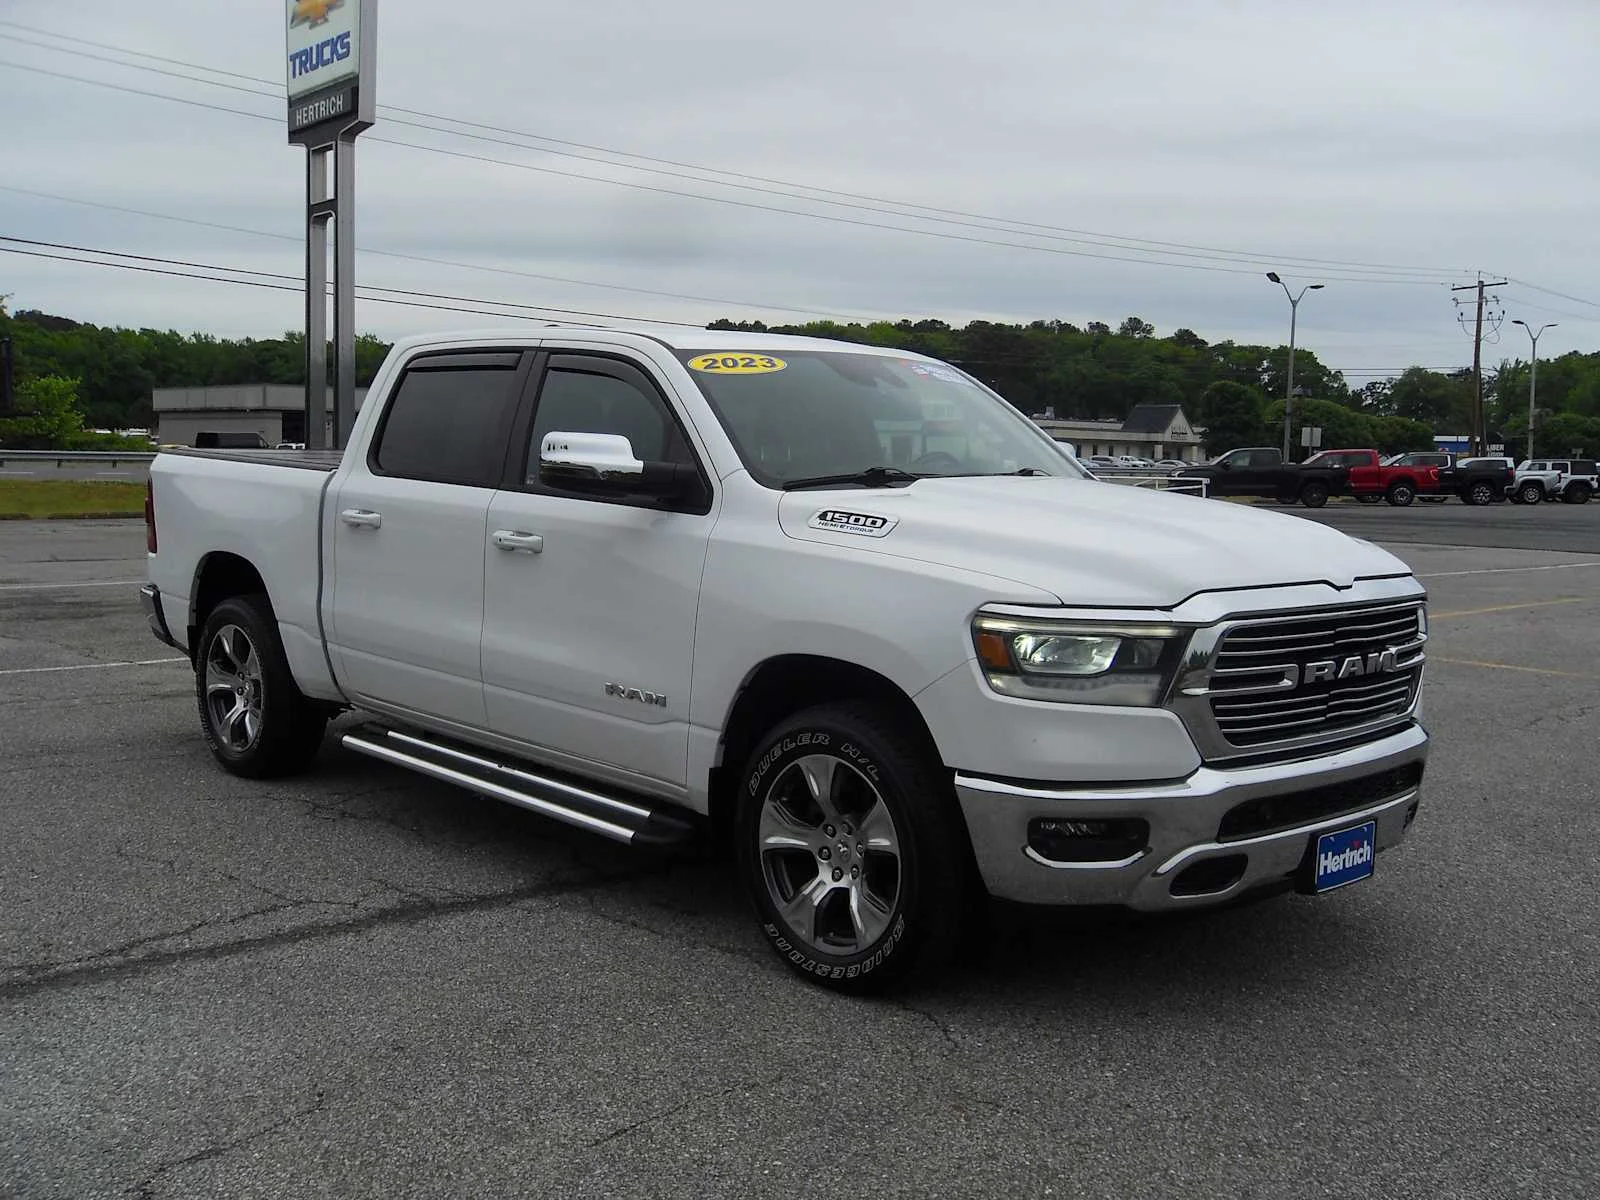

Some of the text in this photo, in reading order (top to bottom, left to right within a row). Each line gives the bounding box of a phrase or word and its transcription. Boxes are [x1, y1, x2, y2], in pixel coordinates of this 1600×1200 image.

[289, 30, 351, 79] TRUCKS
[295, 93, 344, 127] HERTRICH
[702, 357, 777, 370] 2023
[825, 511, 883, 528] 1500
[1303, 648, 1398, 684] RAM
[604, 681, 667, 708] RAM
[749, 732, 831, 796] DUELER
[1319, 840, 1371, 876] Hertrich
[763, 912, 905, 979] BRIDGESTONE
